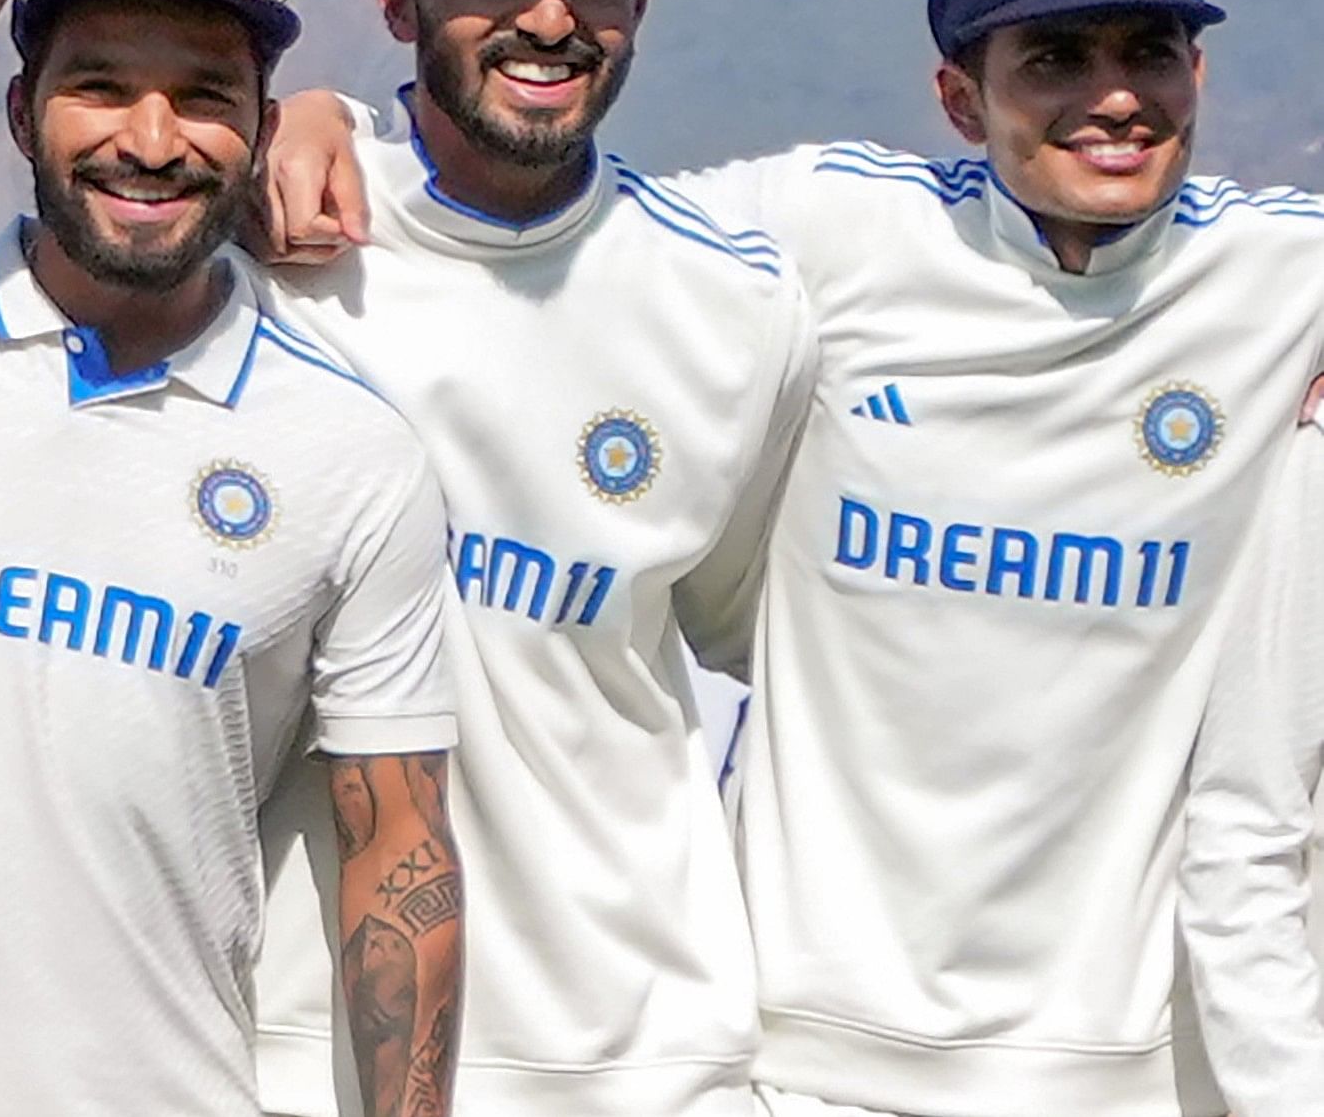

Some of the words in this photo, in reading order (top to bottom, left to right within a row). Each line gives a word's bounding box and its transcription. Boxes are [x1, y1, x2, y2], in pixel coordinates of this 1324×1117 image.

[448, 525, 617, 627] AM11
[834, 496, 1191, 608] DREAM11
[376, 841, 442, 909] XXI
